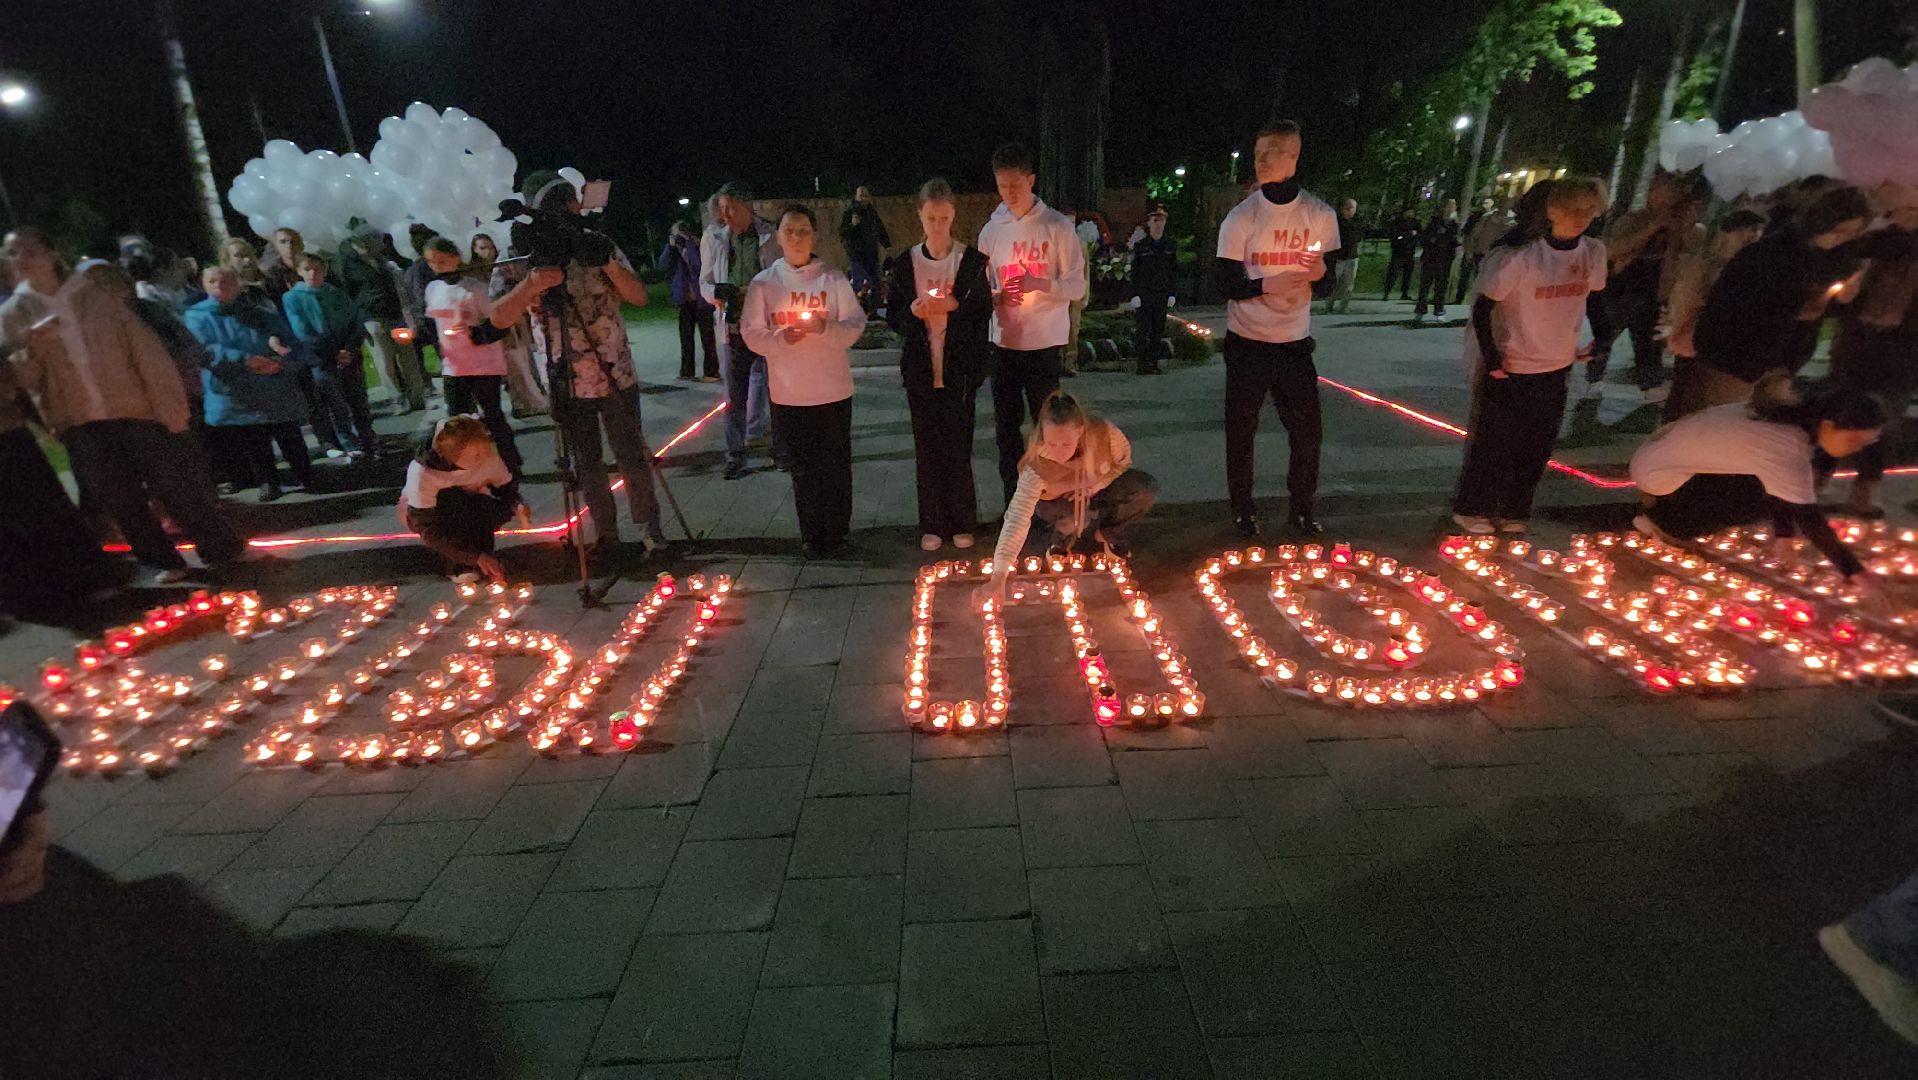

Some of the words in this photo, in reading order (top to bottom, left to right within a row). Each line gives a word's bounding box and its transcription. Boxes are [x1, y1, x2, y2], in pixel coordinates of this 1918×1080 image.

[1013, 239, 1049, 261] МЫ
[1274, 227, 1310, 251] МЫ
[791, 290, 827, 309] МЫ
